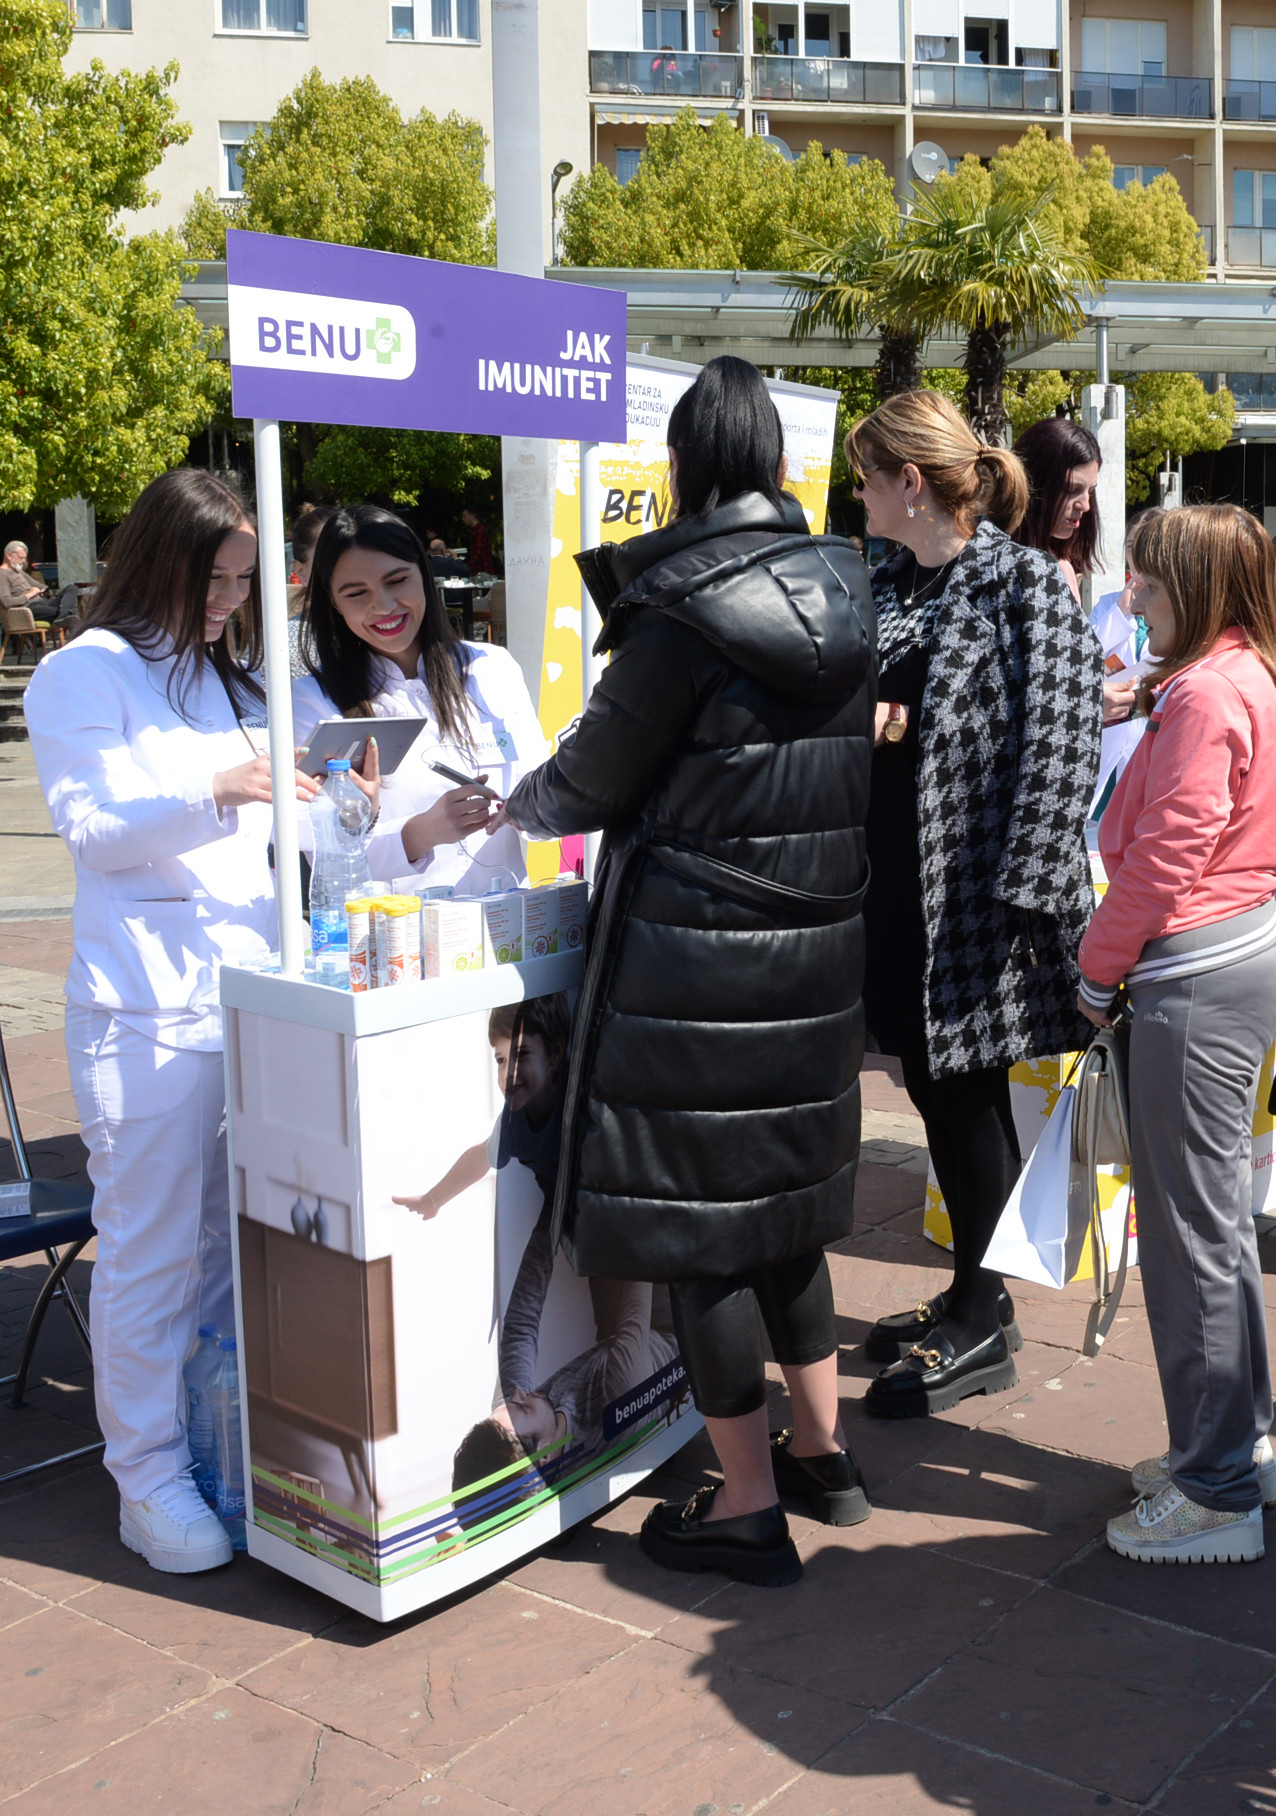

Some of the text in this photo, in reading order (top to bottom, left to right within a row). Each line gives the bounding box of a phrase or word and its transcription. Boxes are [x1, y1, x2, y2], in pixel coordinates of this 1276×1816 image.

[258, 316, 361, 361] BENU
[559, 329, 612, 365] JAK
[478, 358, 612, 402] IMUNITET
[626, 383, 662, 399] ENTAR ZA
[626, 398, 669, 414] MLADINSKU
[626, 412, 661, 428] DUKACIJU
[783, 423, 801, 437] porta
[601, 488, 669, 528] BEN
[615, 1366, 687, 1424] benuapoteka.
